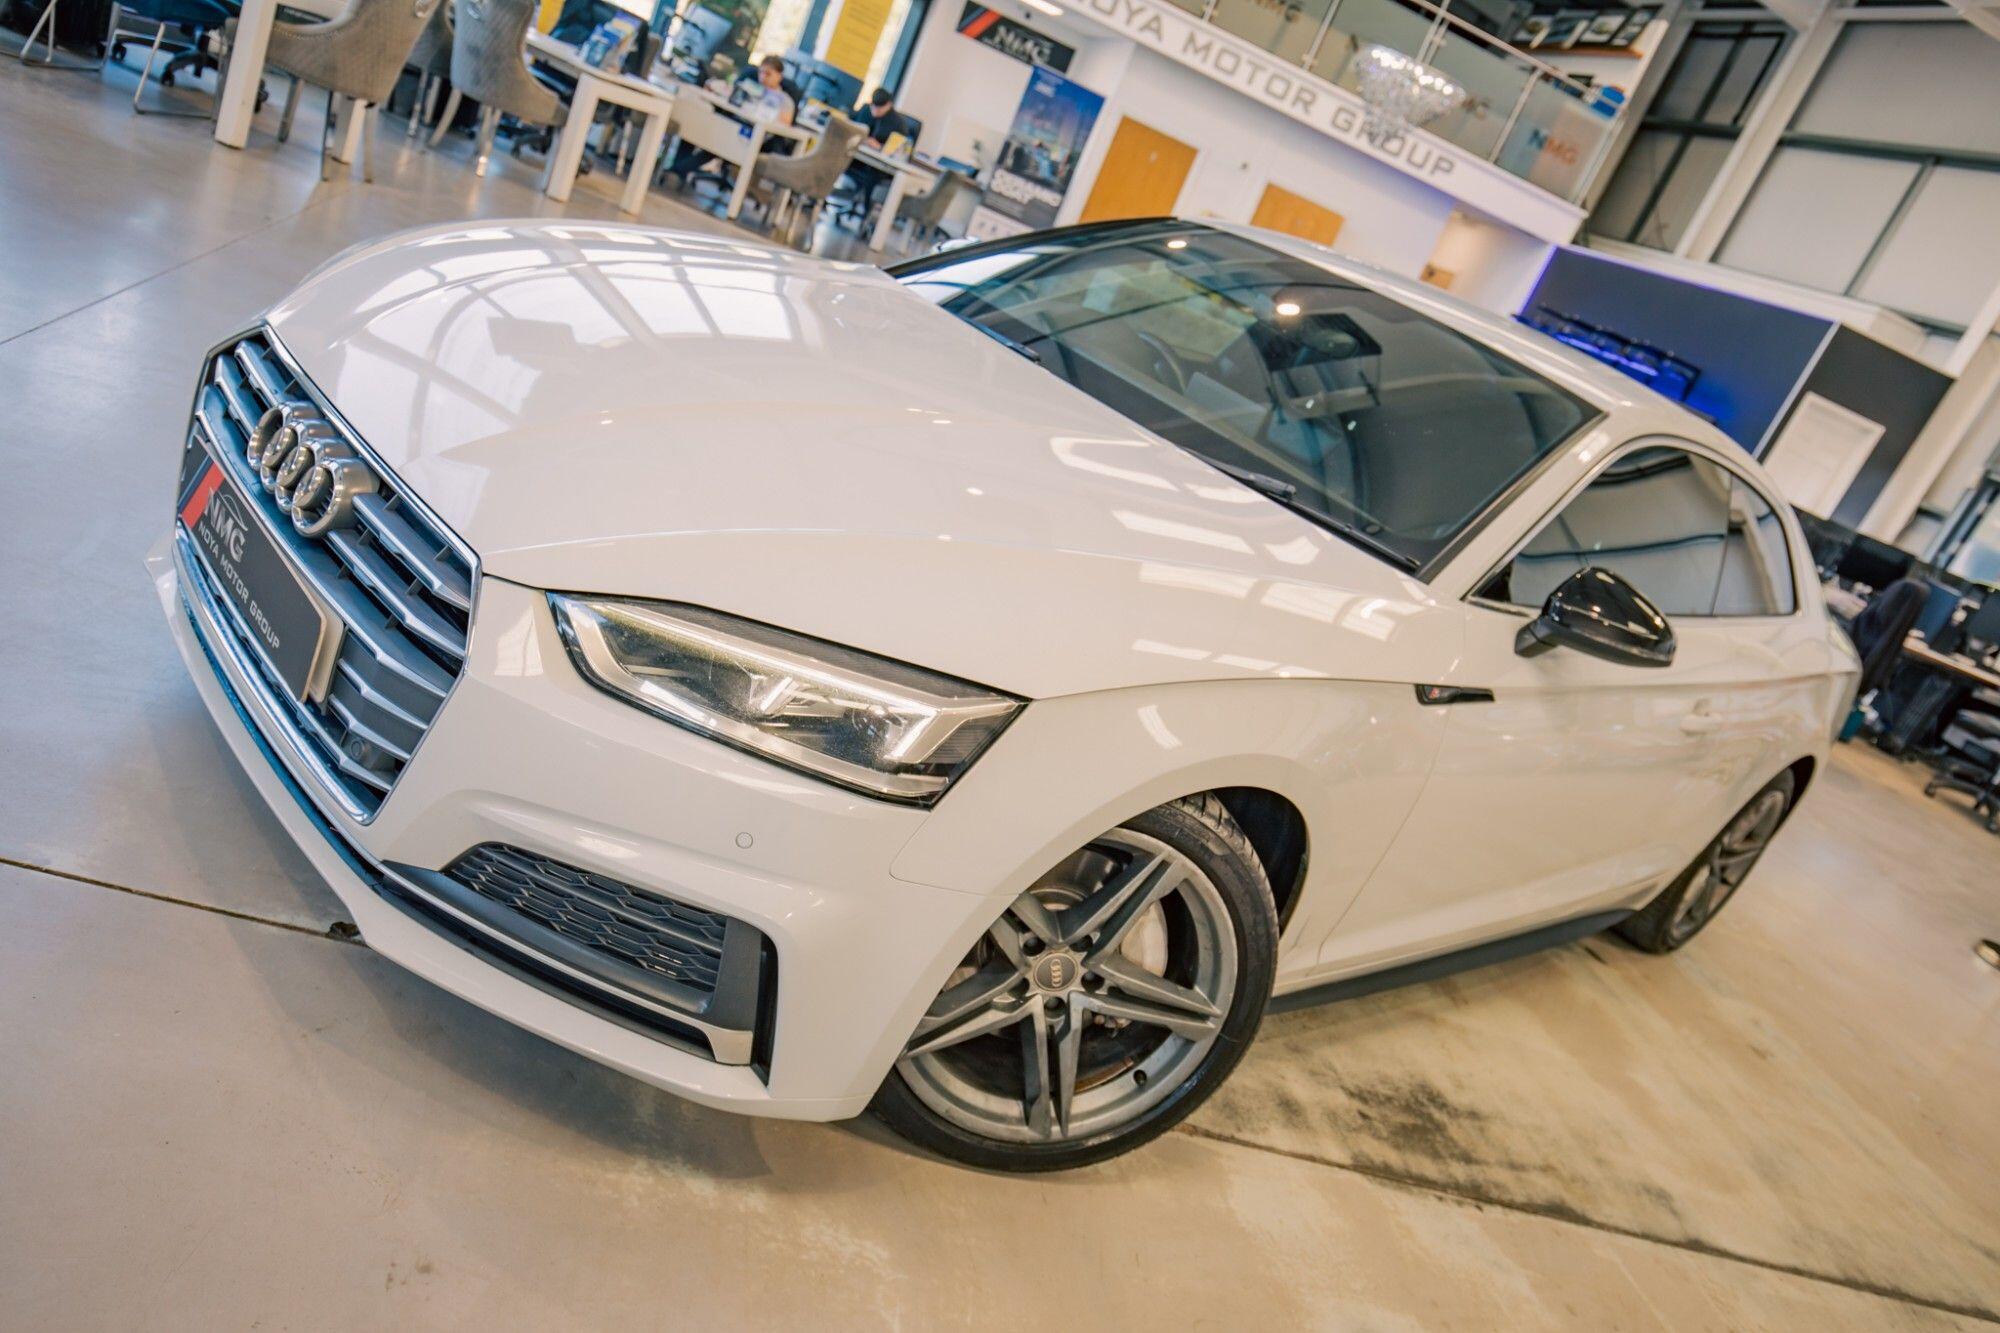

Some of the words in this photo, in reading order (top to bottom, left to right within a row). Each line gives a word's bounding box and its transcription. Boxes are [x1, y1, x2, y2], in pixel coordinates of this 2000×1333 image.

[1078, 0, 1164, 42] OYA
[1183, 32, 1318, 115] MOTOR
[1331, 106, 1456, 176] GROUP
[198, 519, 220, 559] NOYA
[220, 555, 249, 604] MOTOR
[250, 600, 280, 649] GROUP
[204, 486, 246, 563] NMG
